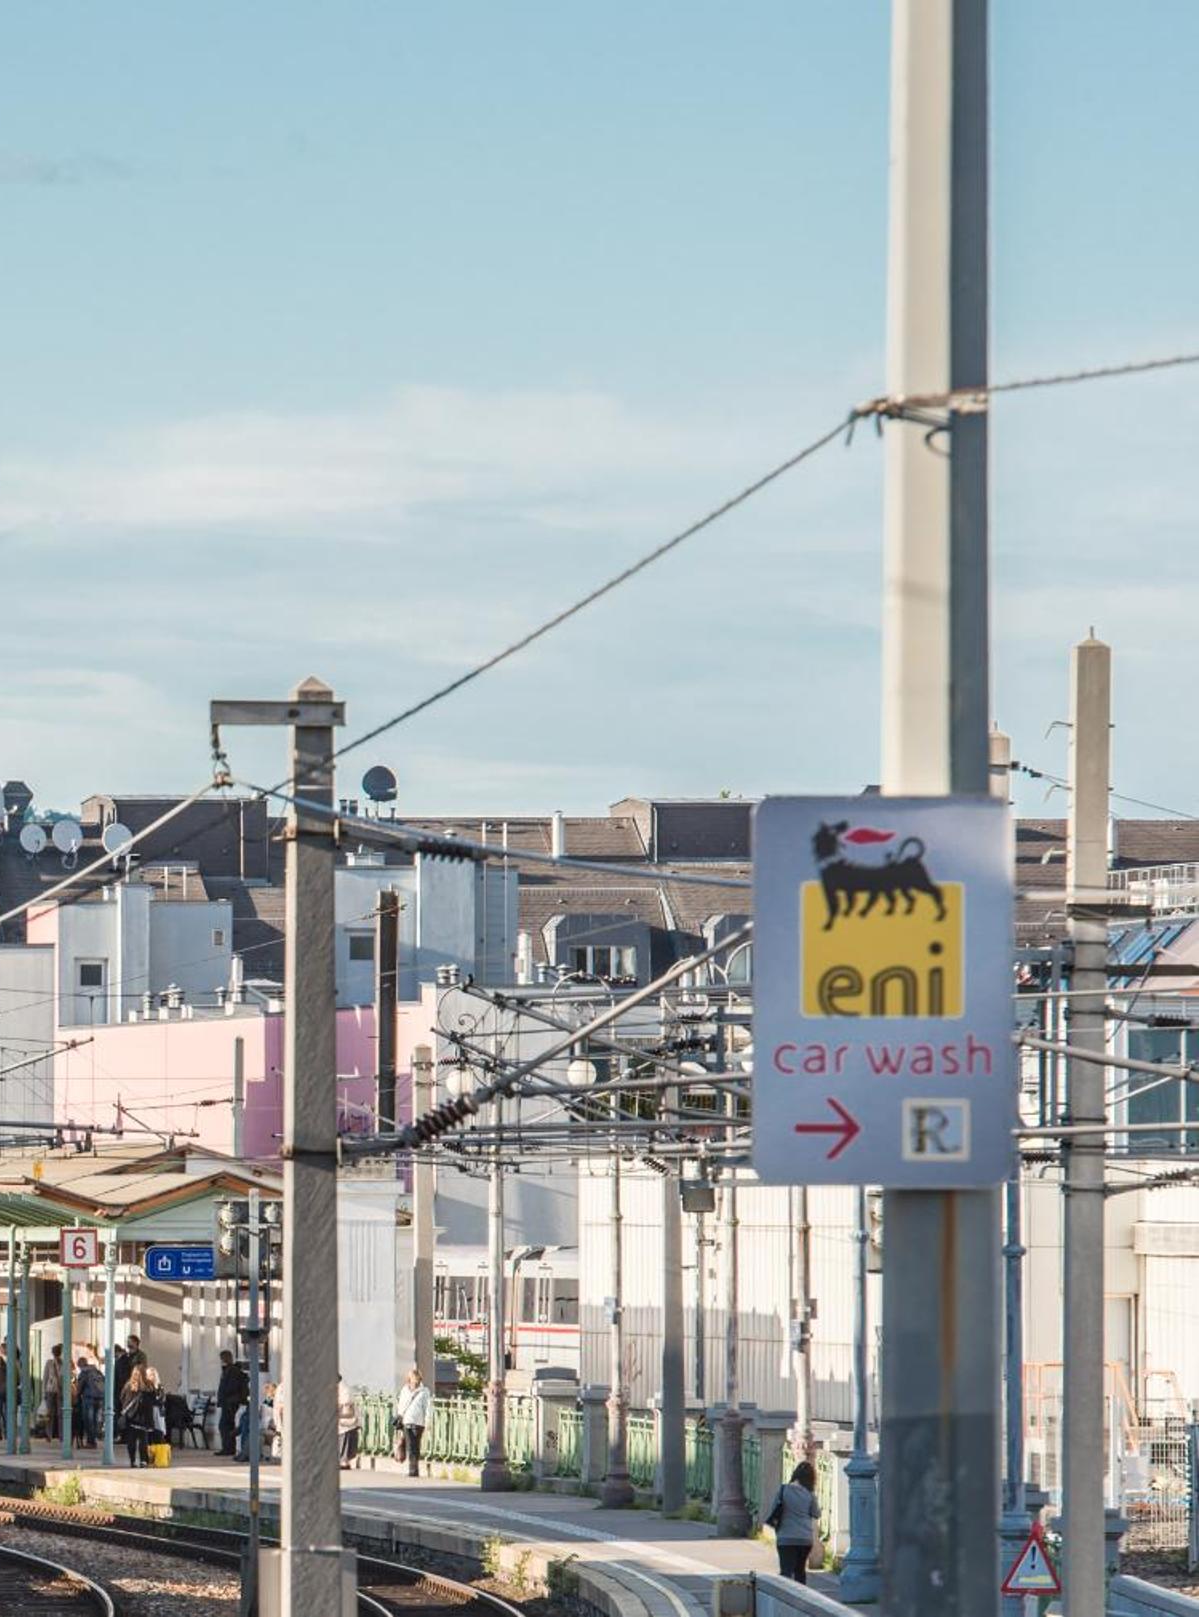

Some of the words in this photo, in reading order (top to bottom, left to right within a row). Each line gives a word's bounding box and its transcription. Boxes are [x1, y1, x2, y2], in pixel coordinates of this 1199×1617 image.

[818, 941, 944, 1018] eni
[773, 1043, 849, 1075] car
[865, 1033, 993, 1075] wash
[910, 1106, 962, 1154] R
[73, 1236, 86, 1259] 6
[182, 1265, 191, 1274] U
